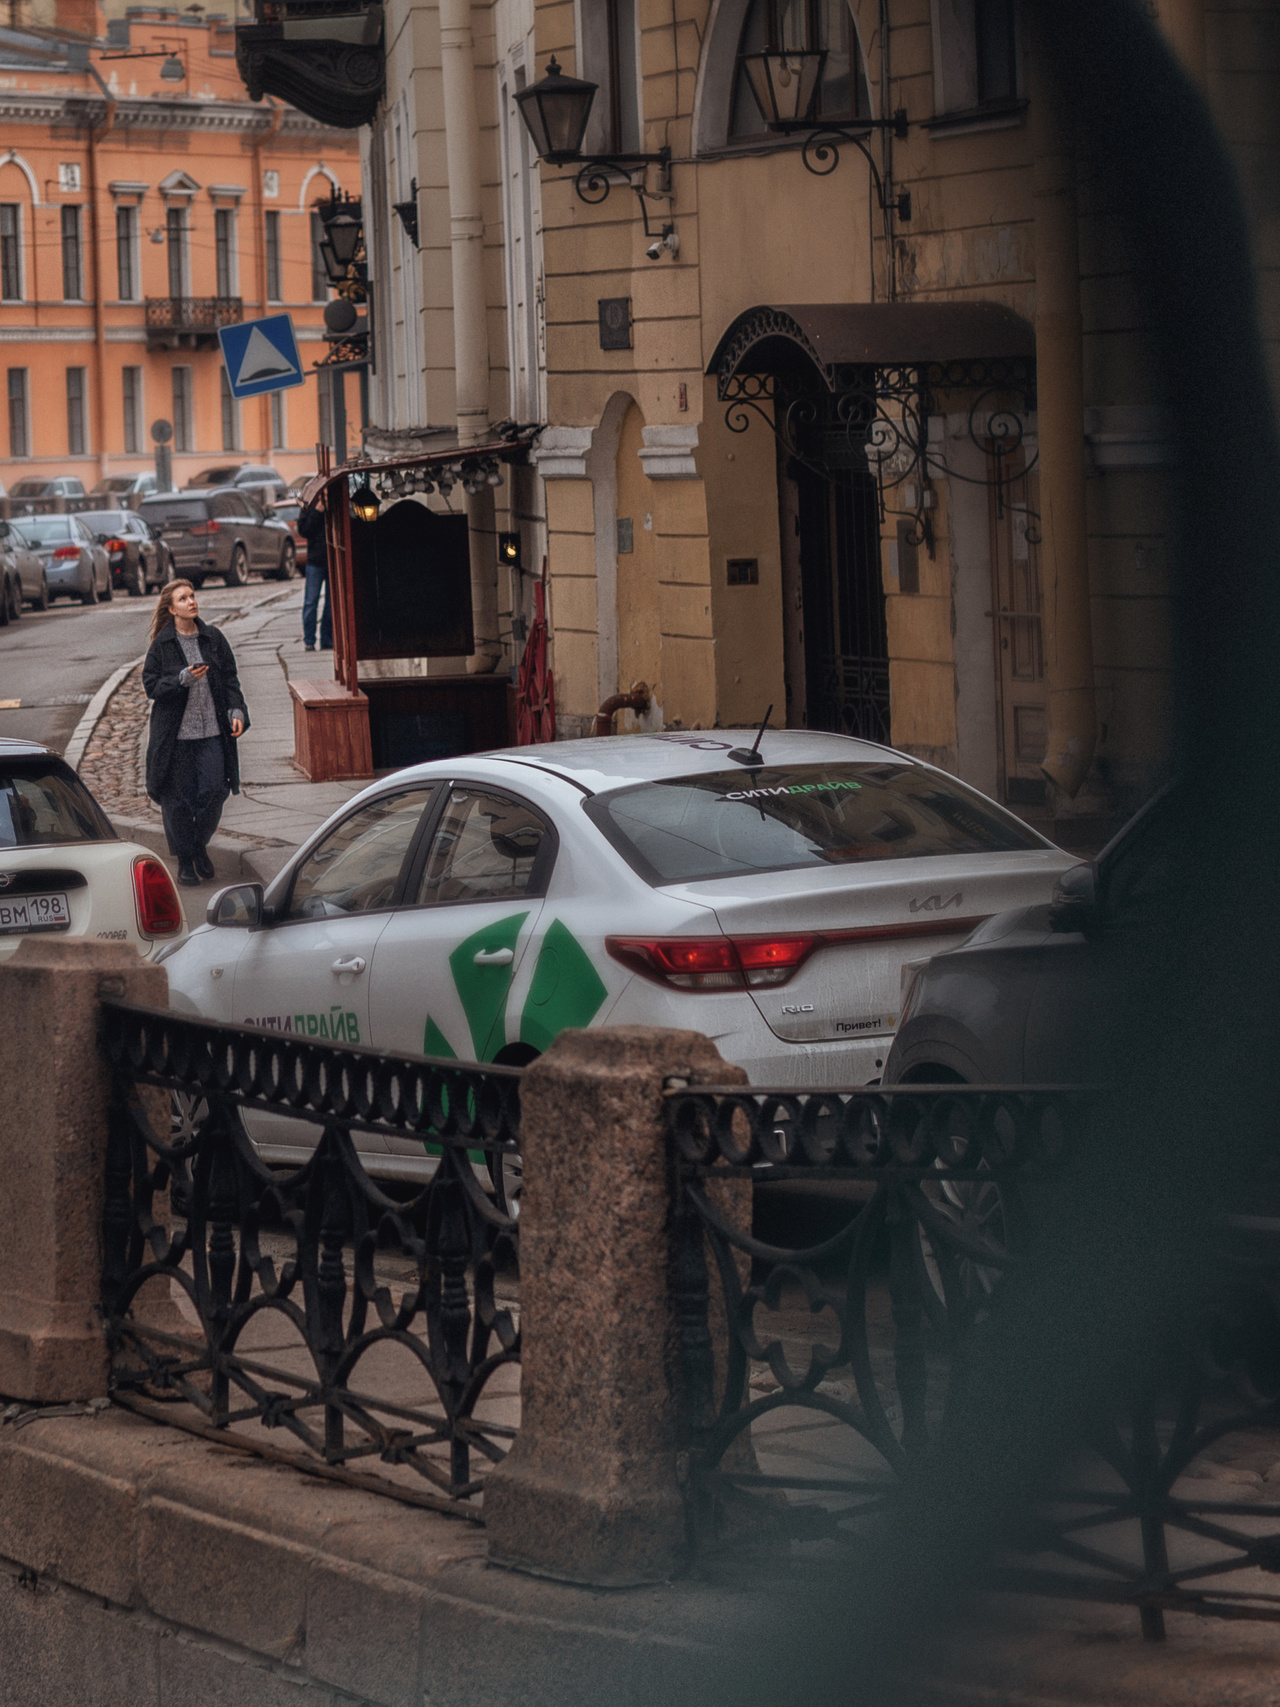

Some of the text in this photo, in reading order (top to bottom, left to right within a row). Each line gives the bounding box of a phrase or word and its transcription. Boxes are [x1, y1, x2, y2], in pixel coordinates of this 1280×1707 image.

[725, 781, 862, 800] СИТИДРАЙВ
[30, 897, 61, 916] 198
[38, 915, 53, 923] RUS
[781, 1003, 814, 1014] RIO
[836, 1018, 881, 1033] Привет!
